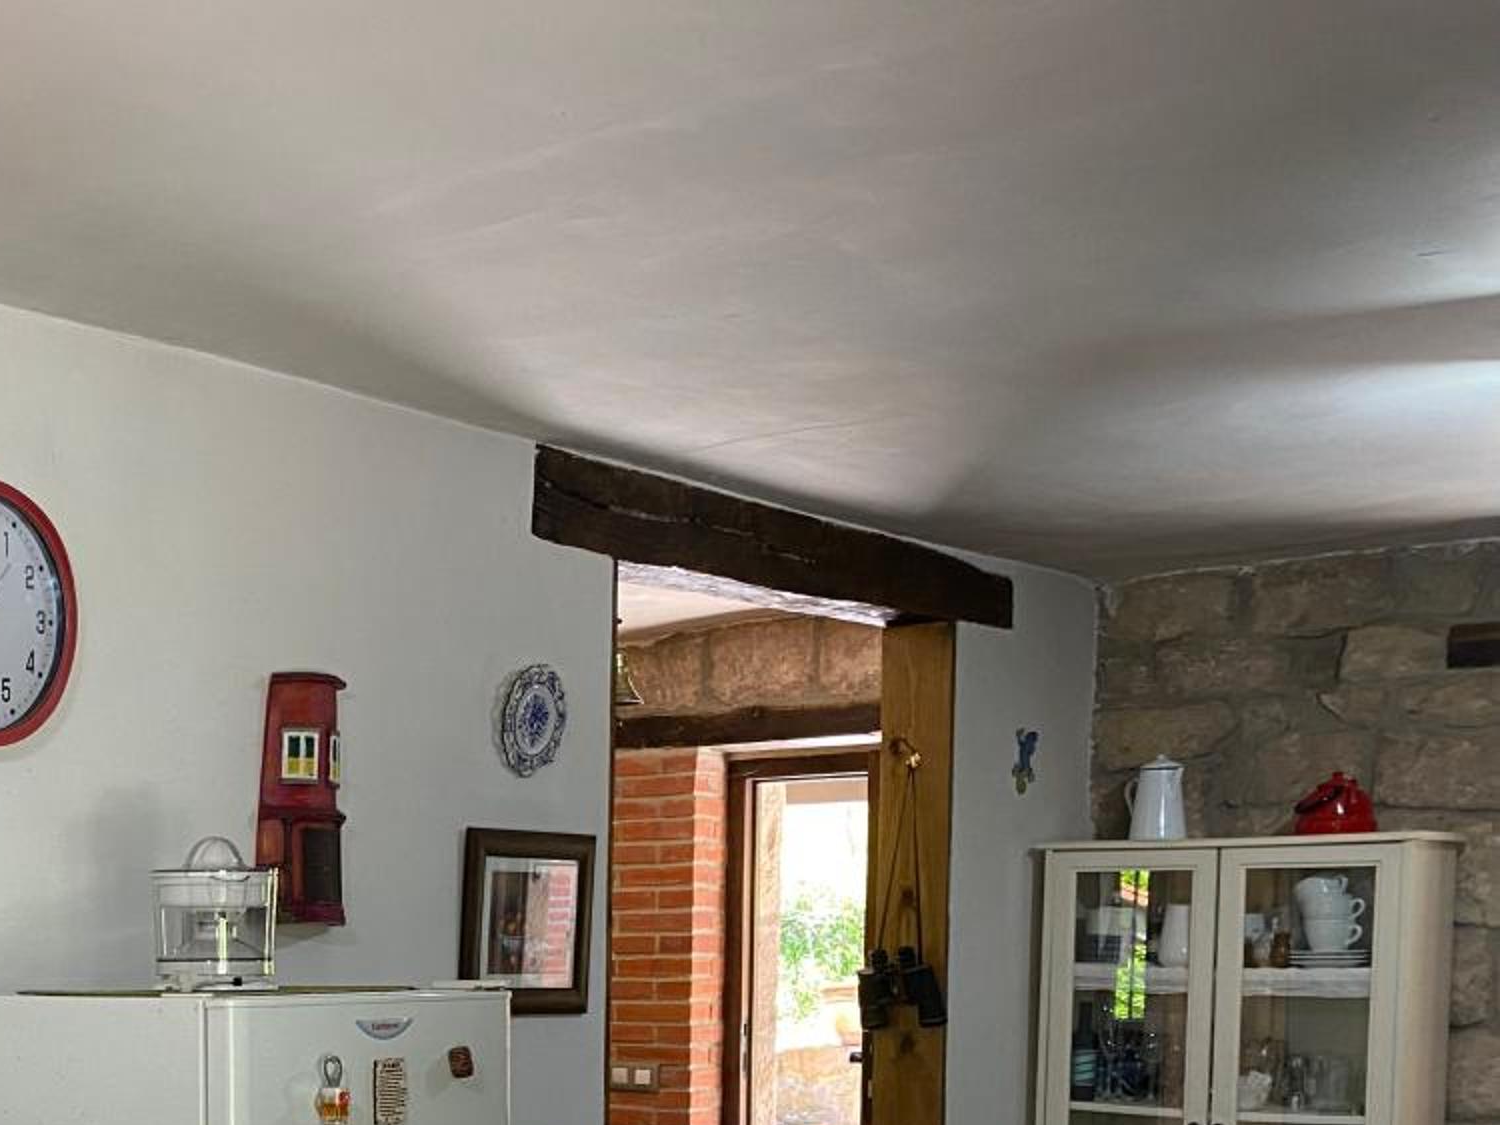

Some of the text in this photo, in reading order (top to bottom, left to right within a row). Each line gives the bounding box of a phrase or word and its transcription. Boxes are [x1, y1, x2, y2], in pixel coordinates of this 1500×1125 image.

[3, 532, 9, 557] 1
[24, 566, 35, 589] 2
[36, 611, 46, 634] 3
[26, 650, 35, 674] 4
[2, 678, 10, 702] 5
